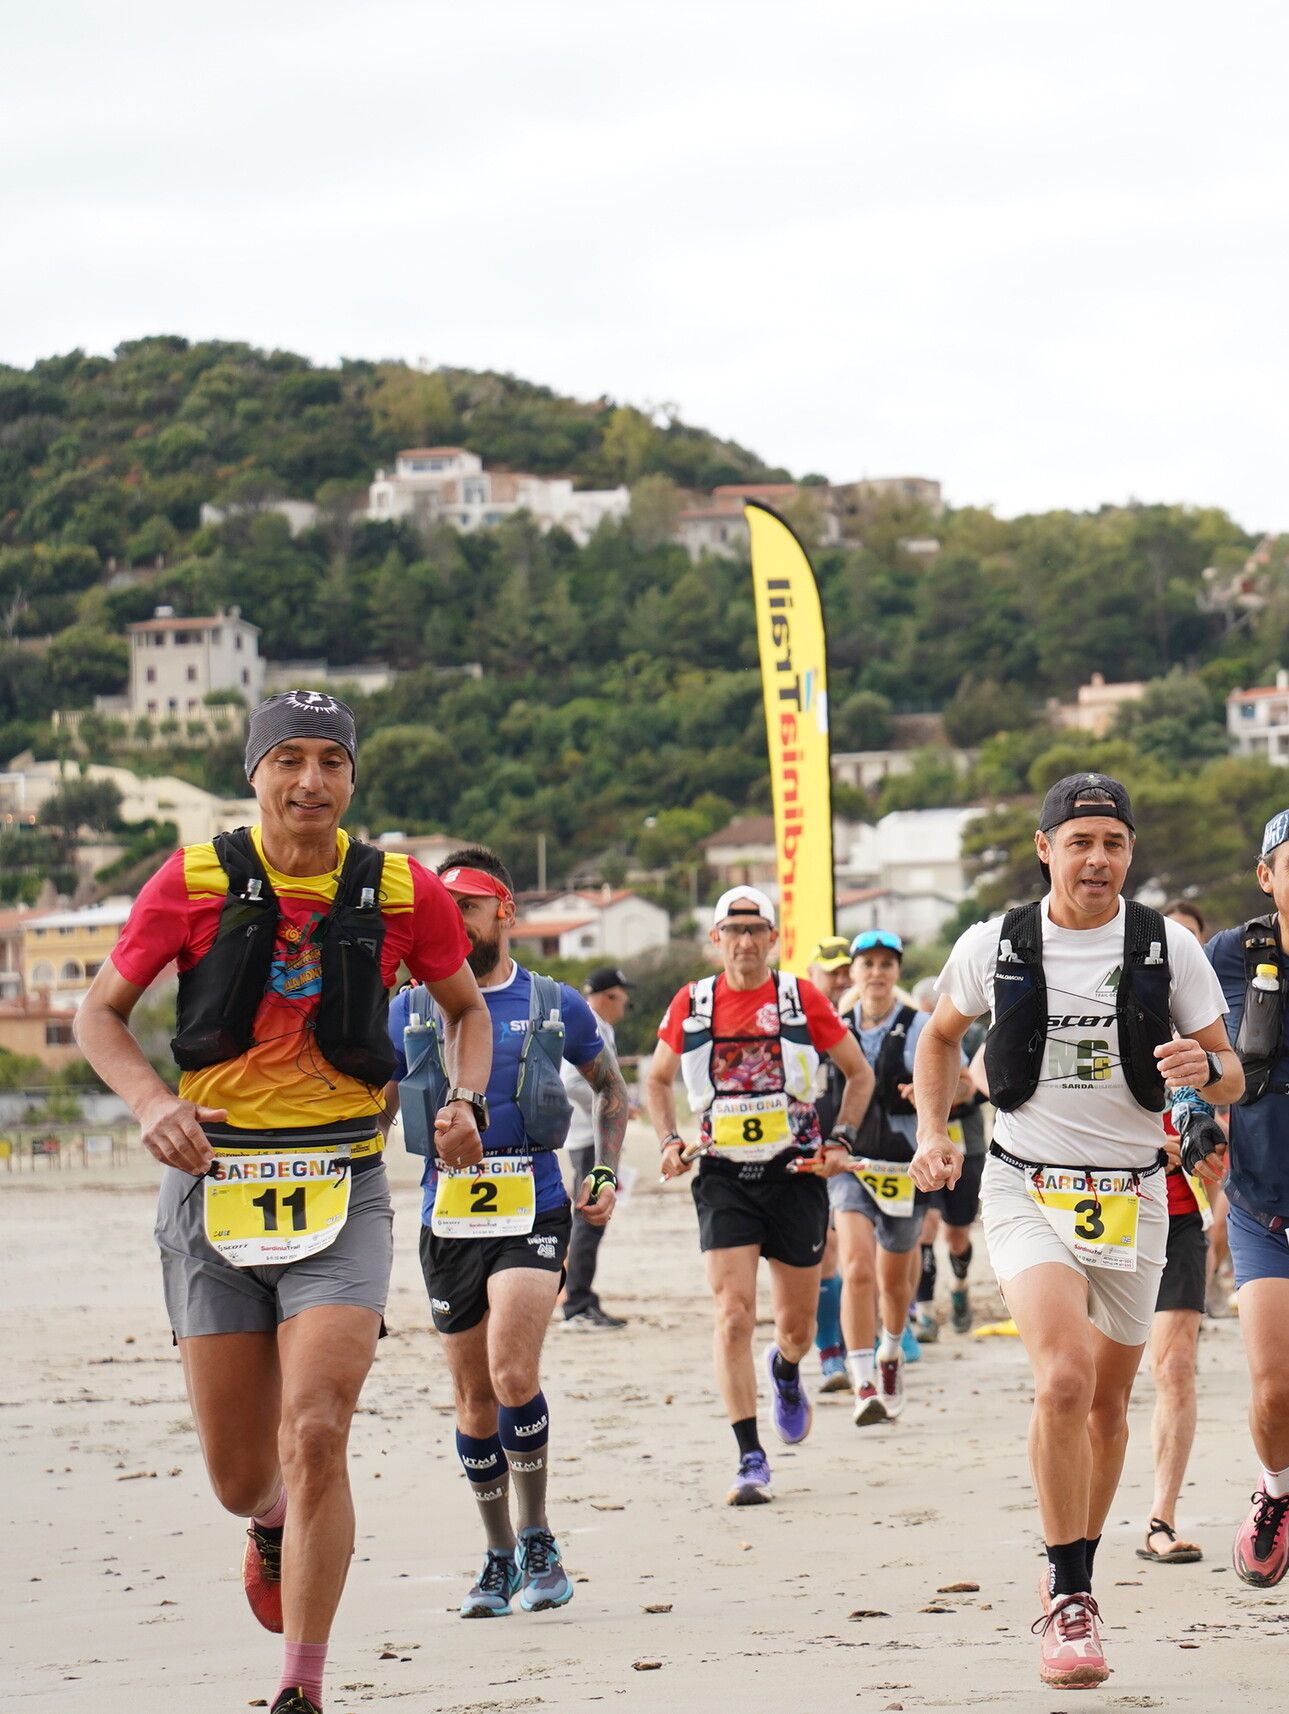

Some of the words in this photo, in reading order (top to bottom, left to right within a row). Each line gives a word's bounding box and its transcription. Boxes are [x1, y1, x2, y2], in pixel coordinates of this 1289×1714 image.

[1047, 1015, 1118, 1028] SCOT
[743, 1118, 763, 1142] 8
[214, 1160, 341, 1180] SARDEGNA
[253, 1187, 307, 1231] 11
[470, 1181, 497, 1213] 2
[1074, 1199, 1105, 1240] 3
